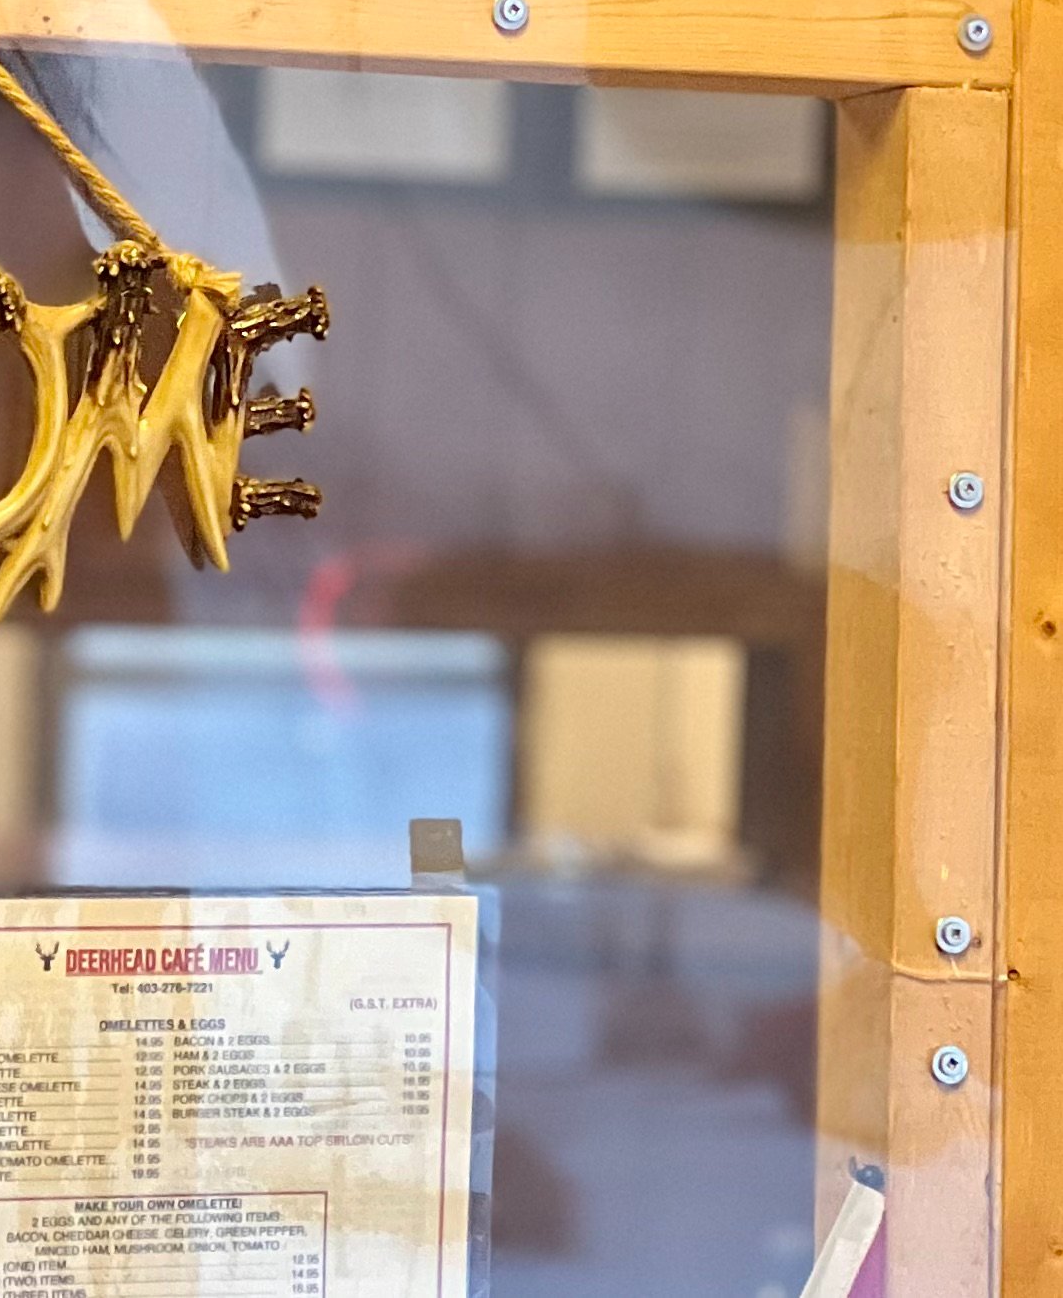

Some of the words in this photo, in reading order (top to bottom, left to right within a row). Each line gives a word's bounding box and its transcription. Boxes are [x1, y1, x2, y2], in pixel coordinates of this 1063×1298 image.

[66, 949, 156, 973] DEERHEAD
[161, 944, 204, 973] CAFÉ
[209, 947, 259, 973] MENU
[112, 983, 133, 993] Tel:
[349, 999, 388, 1010] (G.S.T.
[392, 998, 437, 1010] EXTRA)
[99, 1020, 174, 1032] OMELETTES
[178, 1020, 186, 1030] &
[191, 1019, 226, 1030] EGGS
[173, 1081, 209, 1090] STEAK
[213, 1080, 220, 1089] &
[234, 1080, 265, 1089] EGGS
[44, 1156, 106, 1166] OMELETTE
[75, 1203, 108, 1212] MAKE
[112, 1202, 144, 1211] YOUR
[147, 1202, 174, 1211] OWN
[32, 1218, 38, 1227] 2
[42, 1218, 75, 1227] EGGS
[78, 1217, 102, 1226] AND
[105, 1216, 127, 1225] ANY
[131, 1216, 147, 1225] OF
[151, 1215, 172, 1224] THE
[176, 1213, 242, 1224] FOLLOWING
